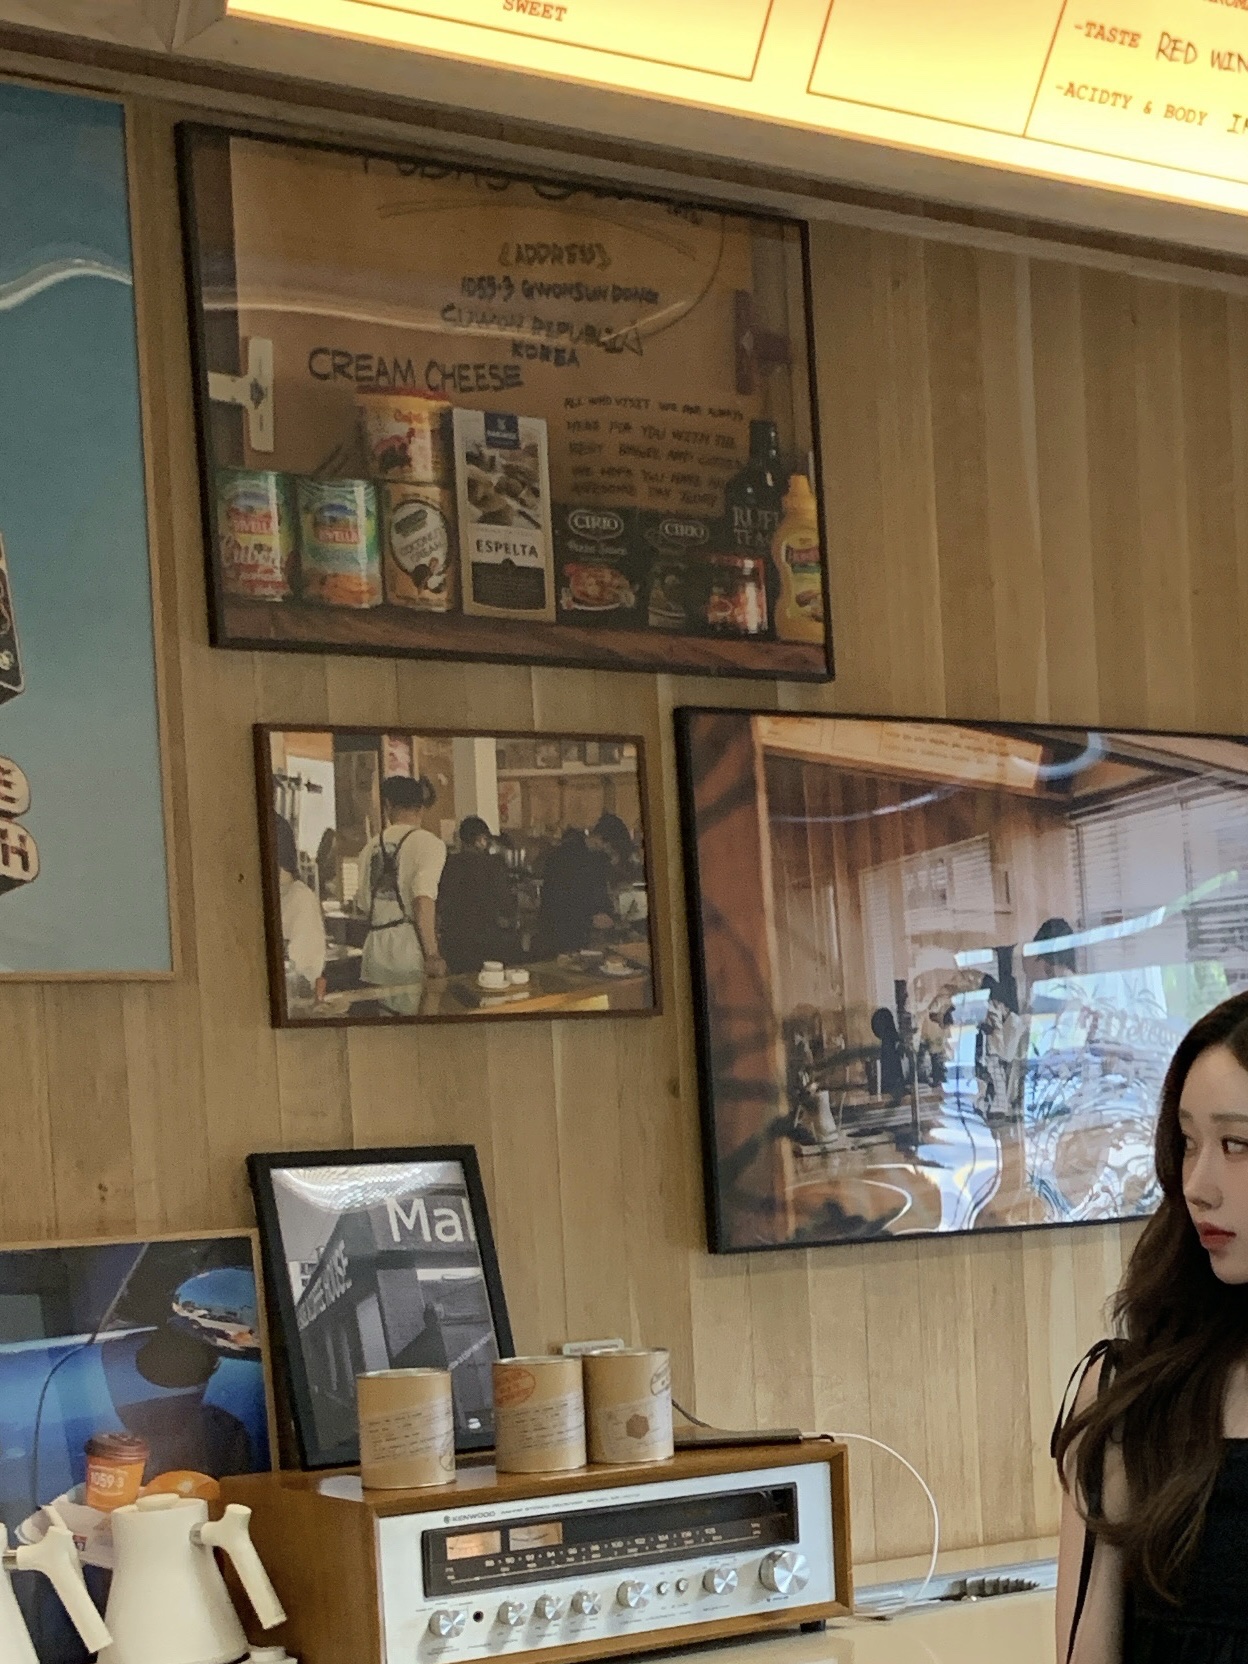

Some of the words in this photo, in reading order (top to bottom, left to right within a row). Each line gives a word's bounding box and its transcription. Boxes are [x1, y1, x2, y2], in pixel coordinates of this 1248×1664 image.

[503, 0, 567, 22] SWEET
[1074, 20, 1142, 49] -TASTE
[1156, 31, 1198, 65] RED
[1143, 101, 1153, 115] &
[1163, 104, 1208, 127] BODY
[308, 347, 416, 388] CREAM
[425, 359, 524, 394] CHEESE
[573, 515, 619, 531] CIRIO
[475, 539, 538, 559] ESPELTA
[452, 1511, 496, 1522] KENWOOD
